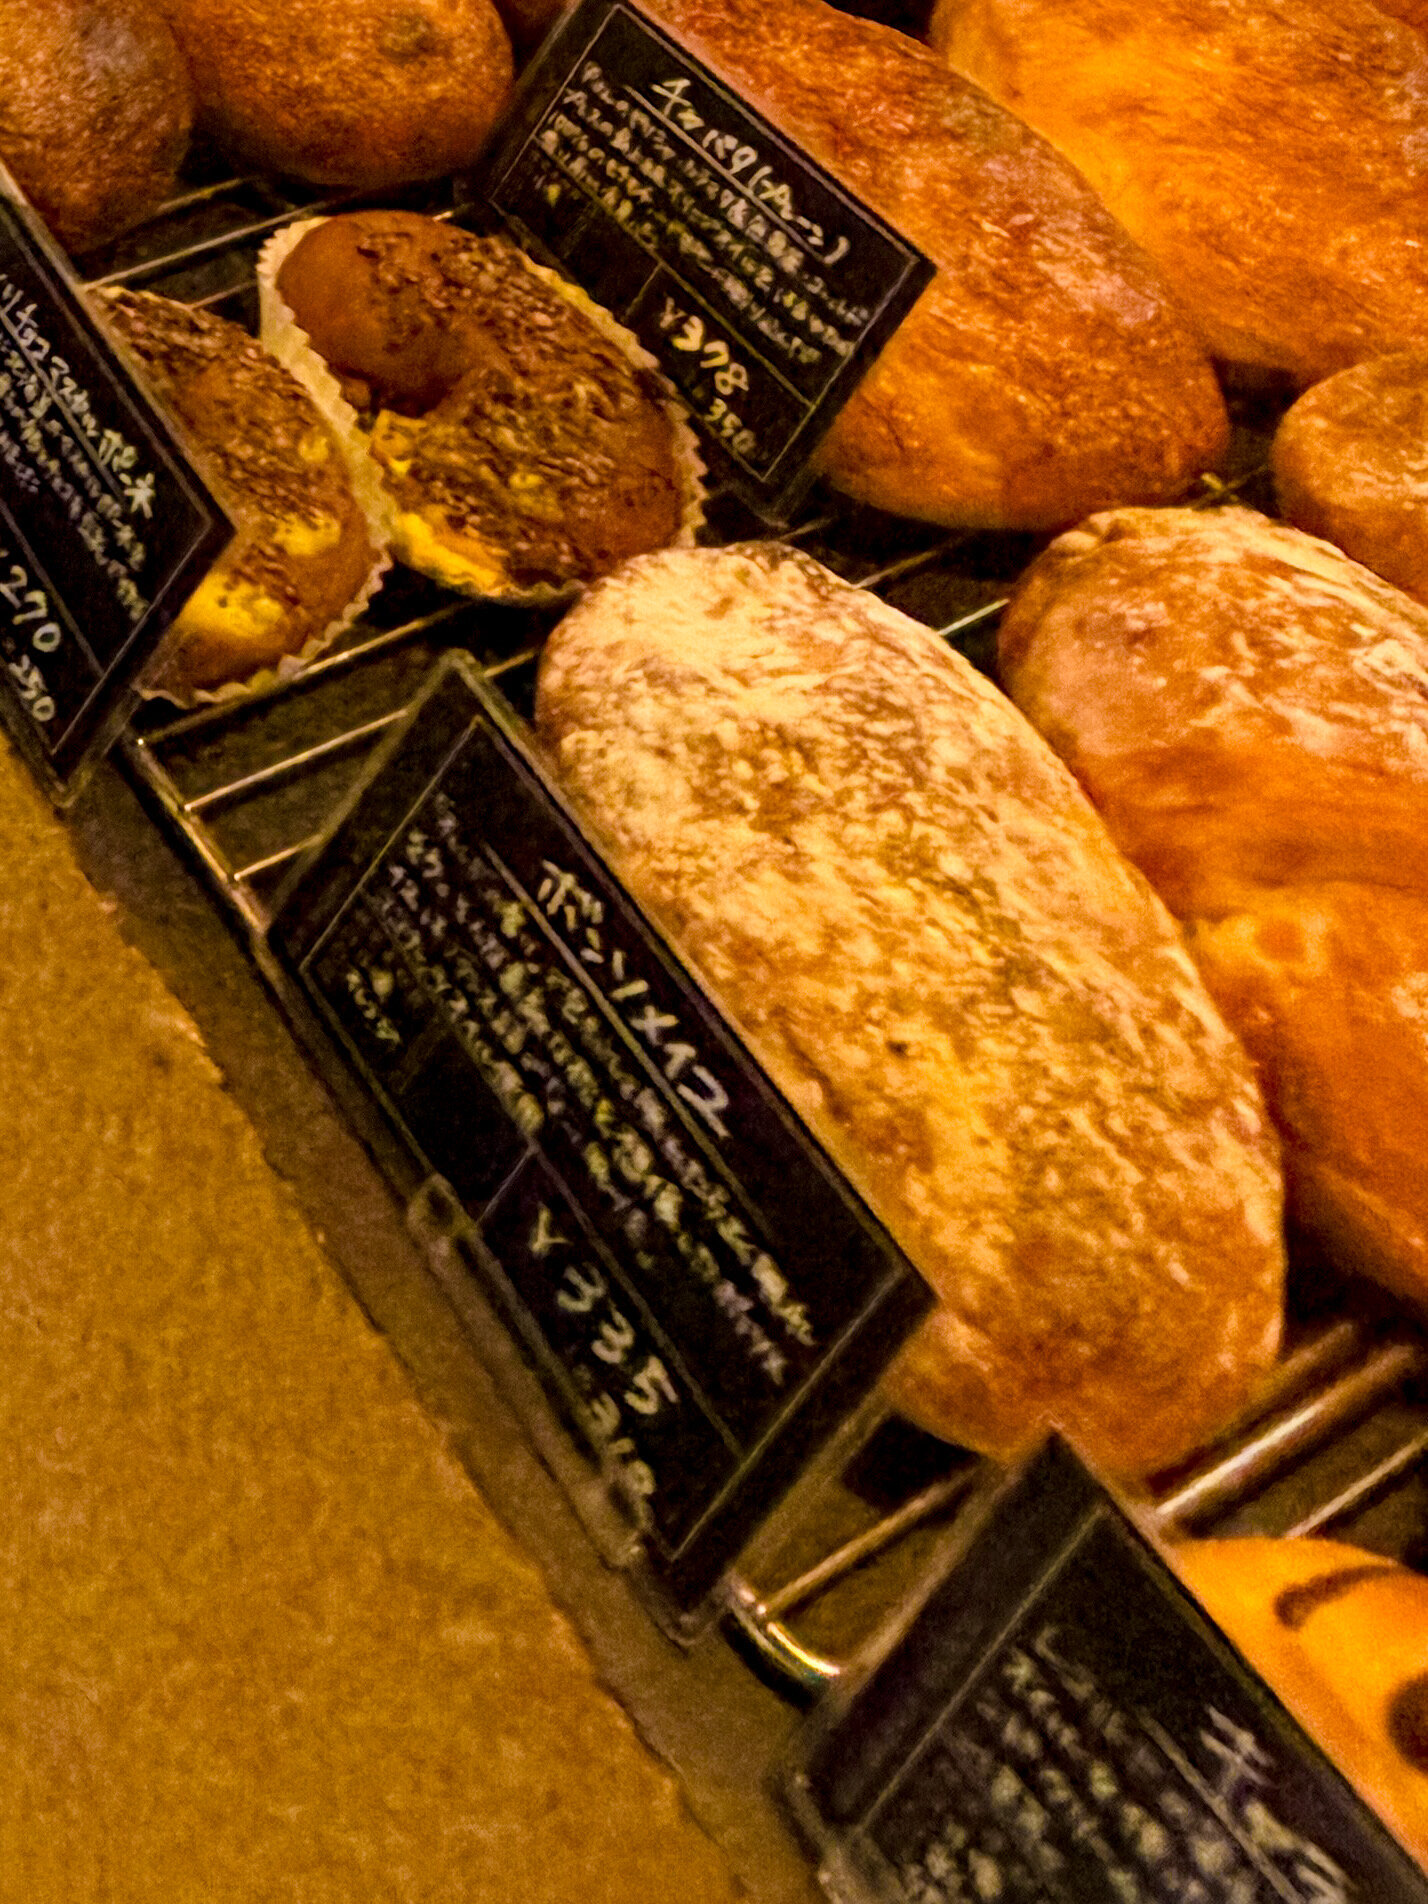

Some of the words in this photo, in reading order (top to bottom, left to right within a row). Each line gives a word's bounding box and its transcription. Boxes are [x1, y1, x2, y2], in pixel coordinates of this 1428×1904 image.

[660, 299, 748, 395] ¥378
[8, 654, 54, 721] 250
[530, 1208, 676, 1414] ¥335
